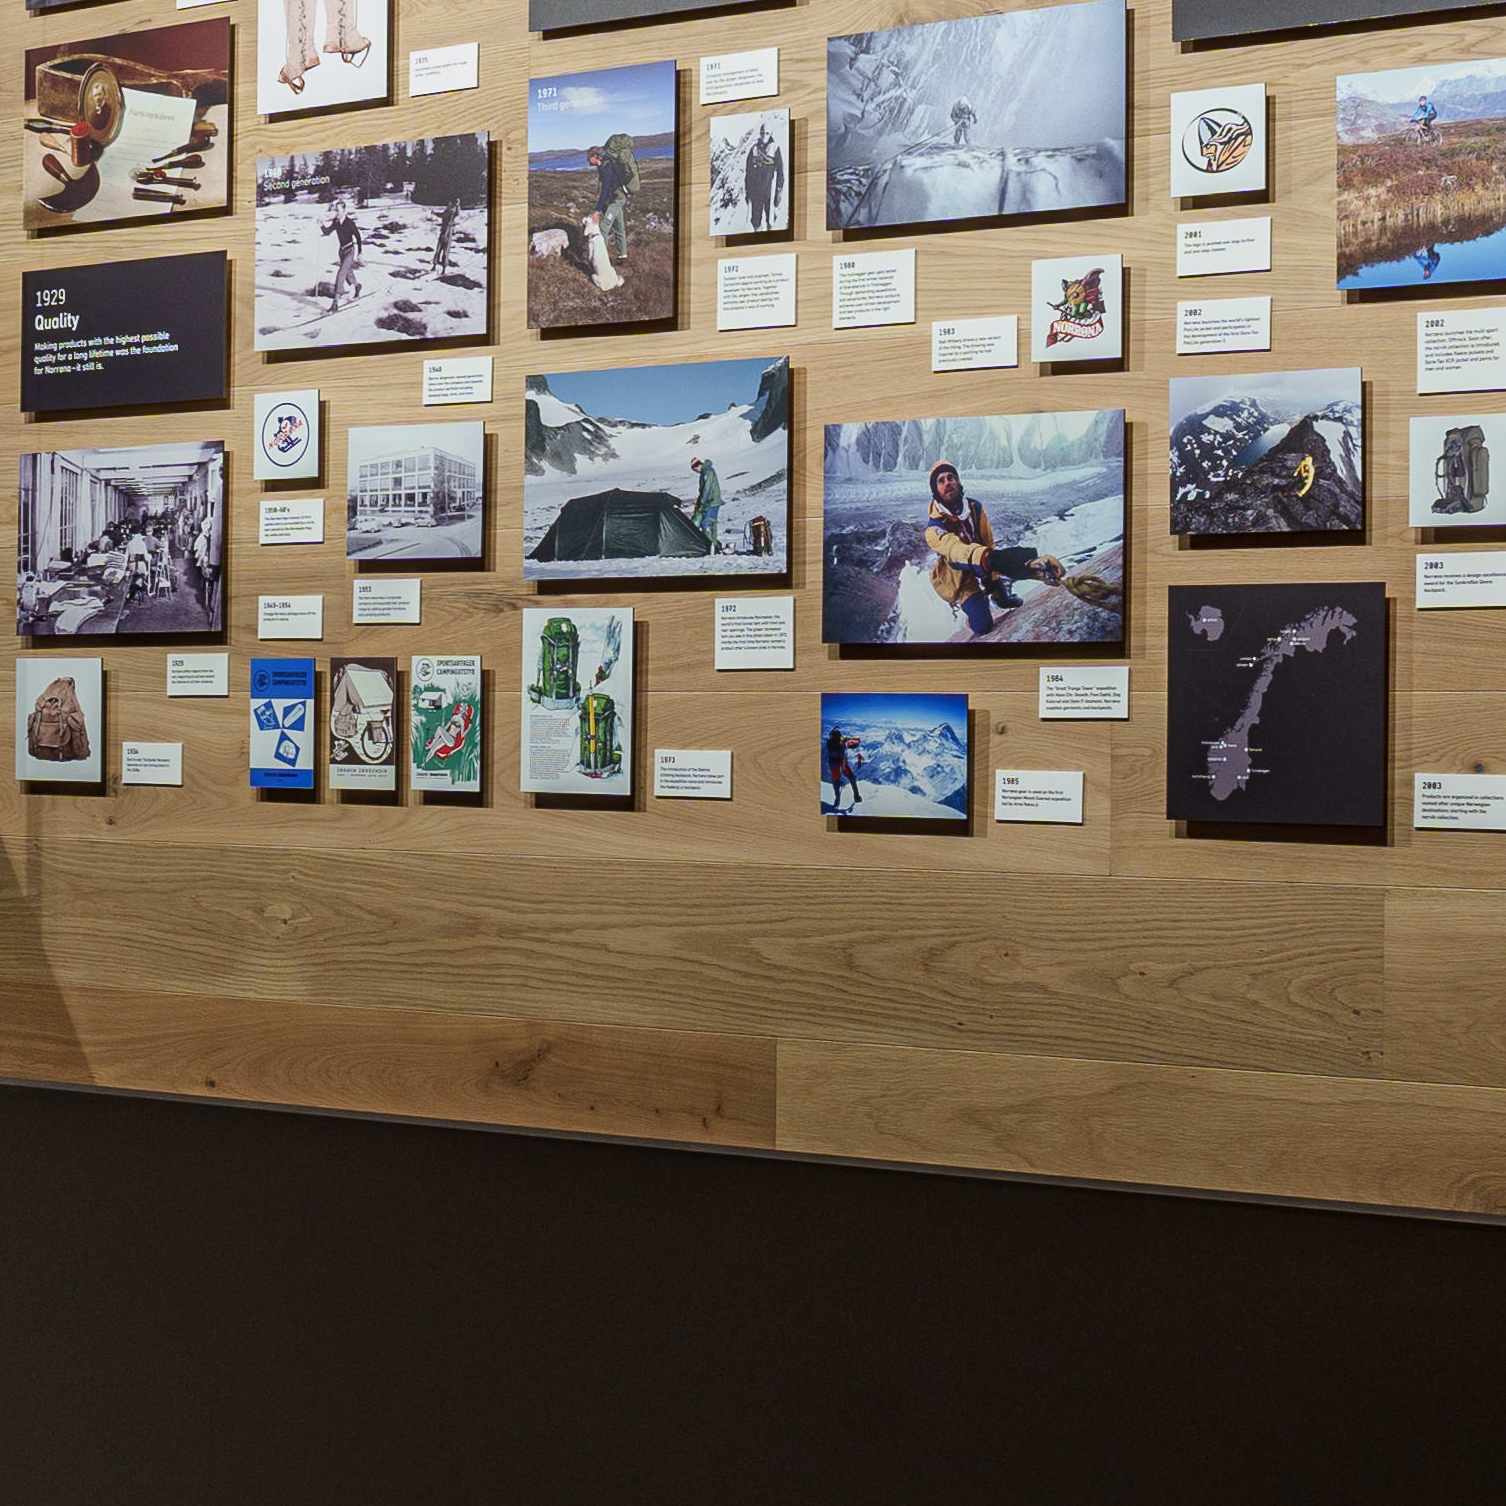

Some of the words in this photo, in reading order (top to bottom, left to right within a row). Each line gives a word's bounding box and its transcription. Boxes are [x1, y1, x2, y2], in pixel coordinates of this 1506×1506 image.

[537, 87, 558, 99] 1971
[36, 288, 66, 307] 1929
[34, 312, 80, 331] Quality
